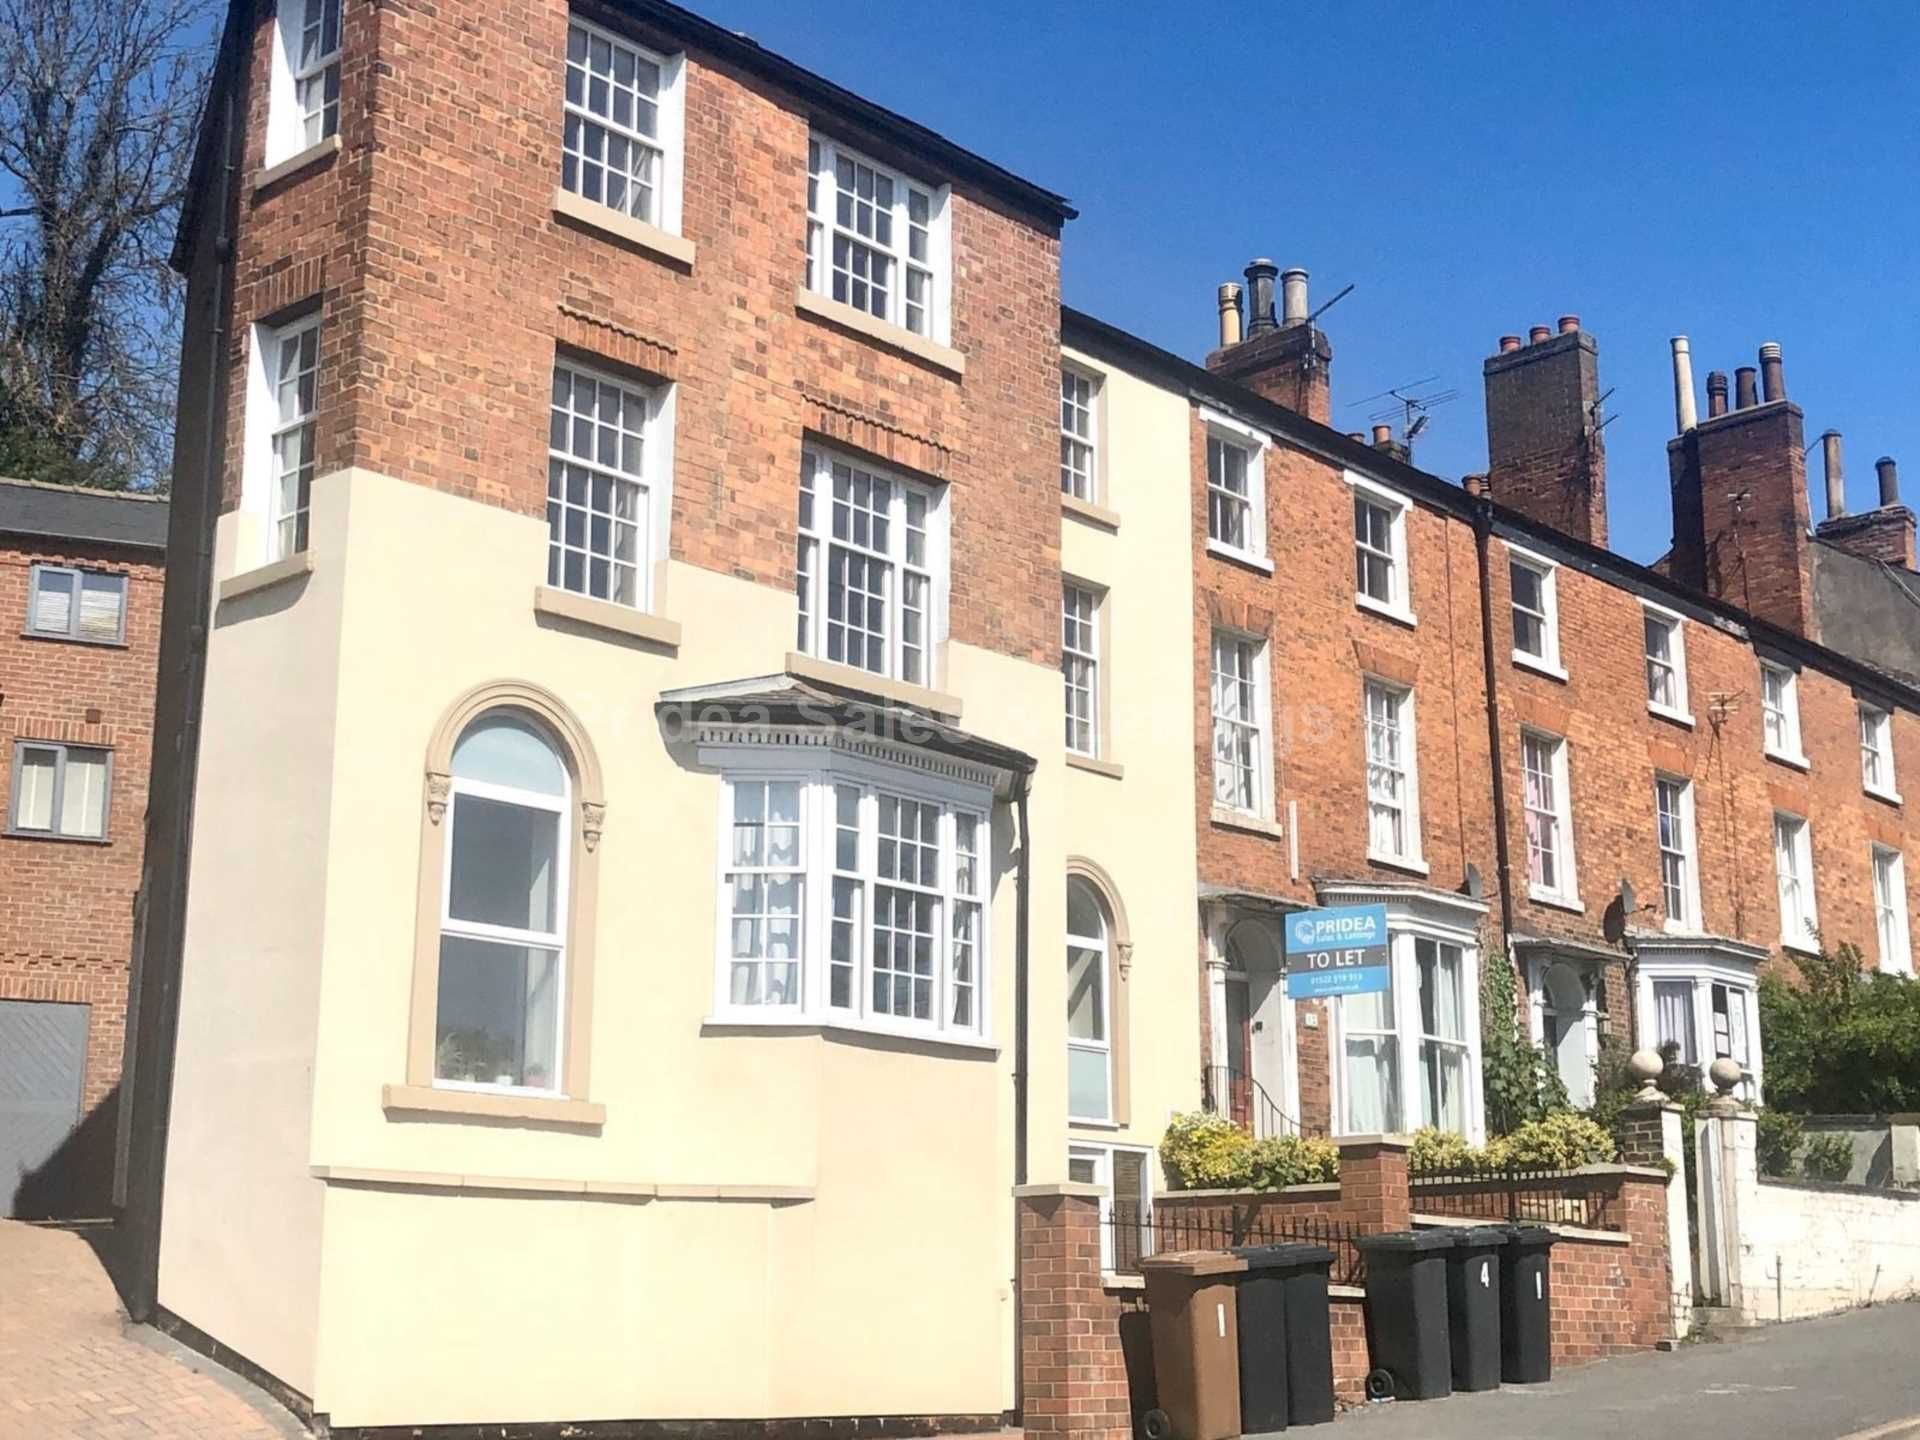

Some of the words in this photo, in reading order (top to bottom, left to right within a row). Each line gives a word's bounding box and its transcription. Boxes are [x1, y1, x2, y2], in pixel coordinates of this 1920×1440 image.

[1316, 916, 1376, 934] PRIDEA
[1307, 952, 1329, 968] TO
[1336, 949, 1365, 966] LET
[1480, 1261, 1490, 1289] 4
